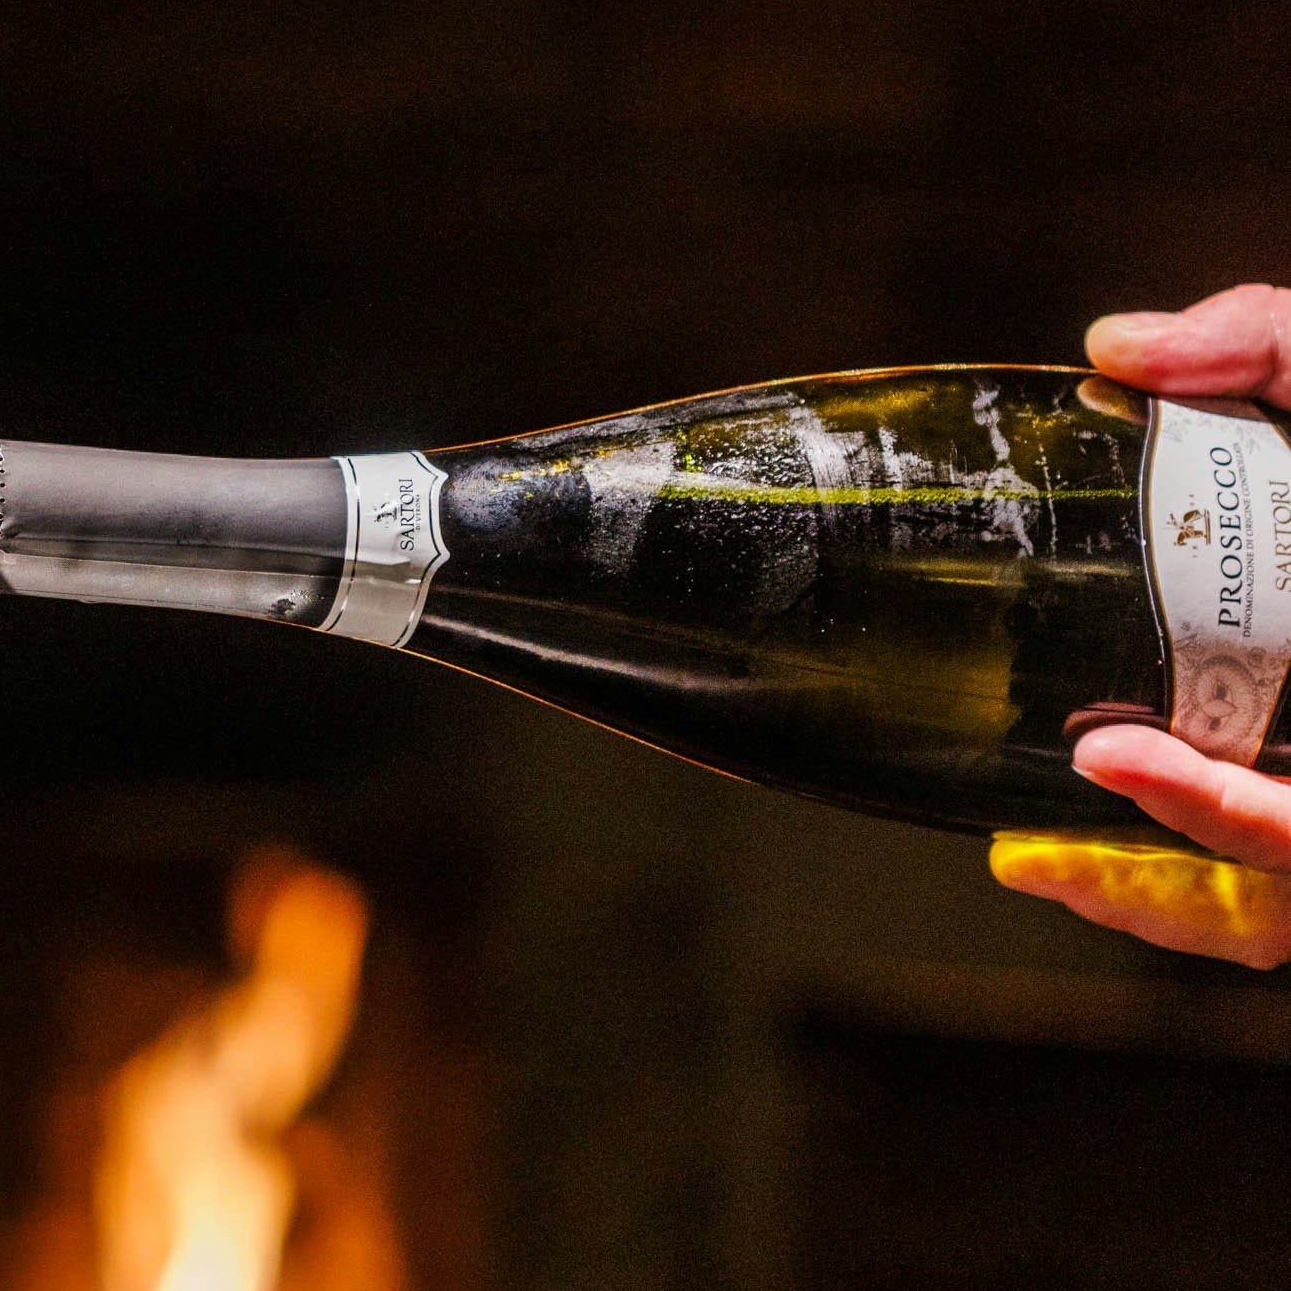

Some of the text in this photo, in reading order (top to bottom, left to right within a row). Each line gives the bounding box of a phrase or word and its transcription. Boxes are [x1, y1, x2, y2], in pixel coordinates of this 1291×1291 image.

[398, 478, 415, 551] SARTORI
[1209, 447, 1243, 628] PROSECCO
[1243, 498, 1254, 537] ORIGINE
[1269, 478, 1291, 593] SARTORI
[1243, 552, 1255, 638] DENOMINAZIONE
